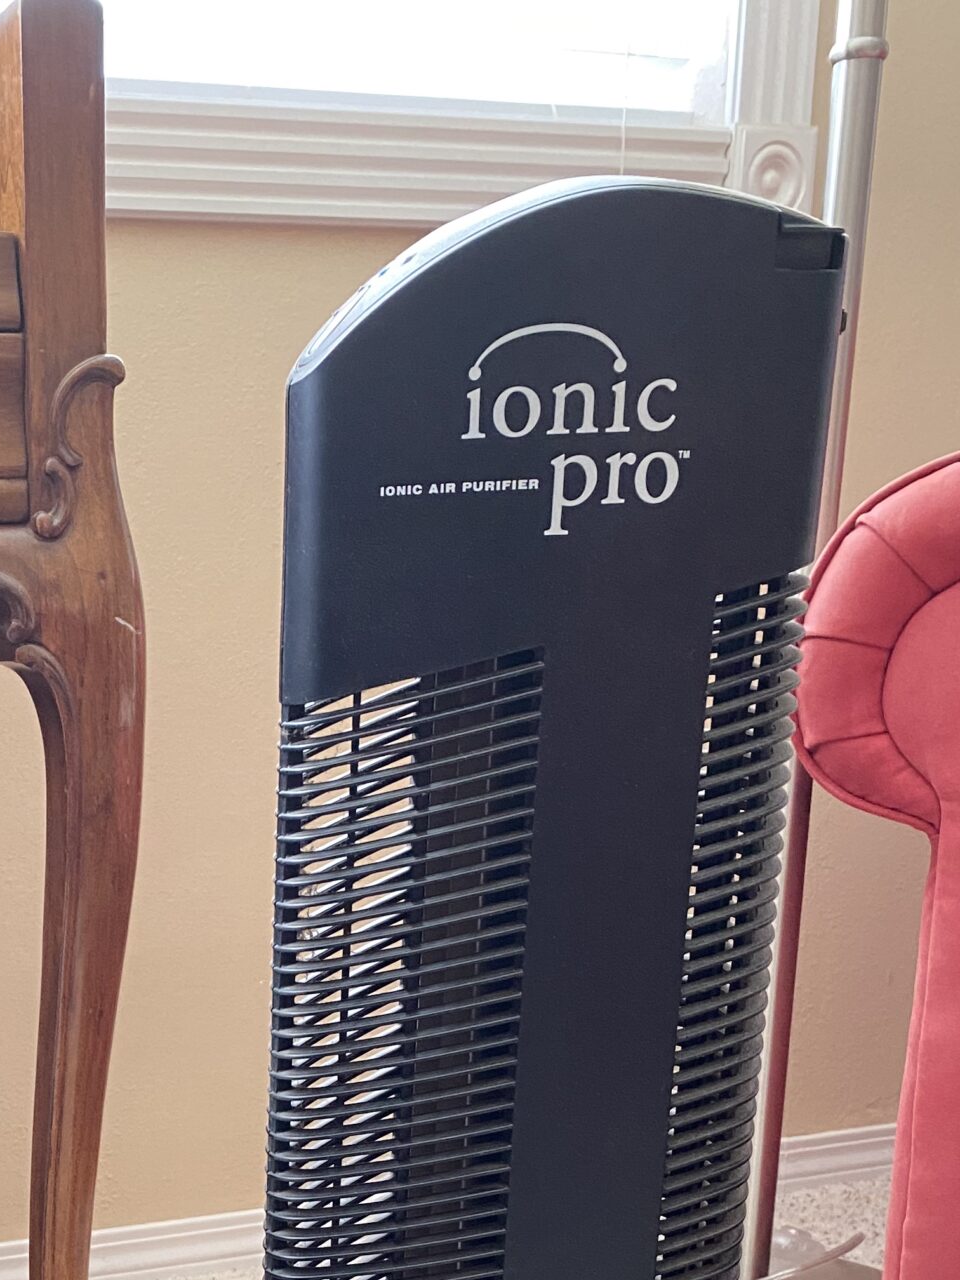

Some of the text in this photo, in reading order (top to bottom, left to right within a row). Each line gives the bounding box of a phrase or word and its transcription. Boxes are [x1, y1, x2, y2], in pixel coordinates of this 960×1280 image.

[460, 356, 678, 440] ionic
[379, 478, 540, 497] IONIC AIR PURIFIER
